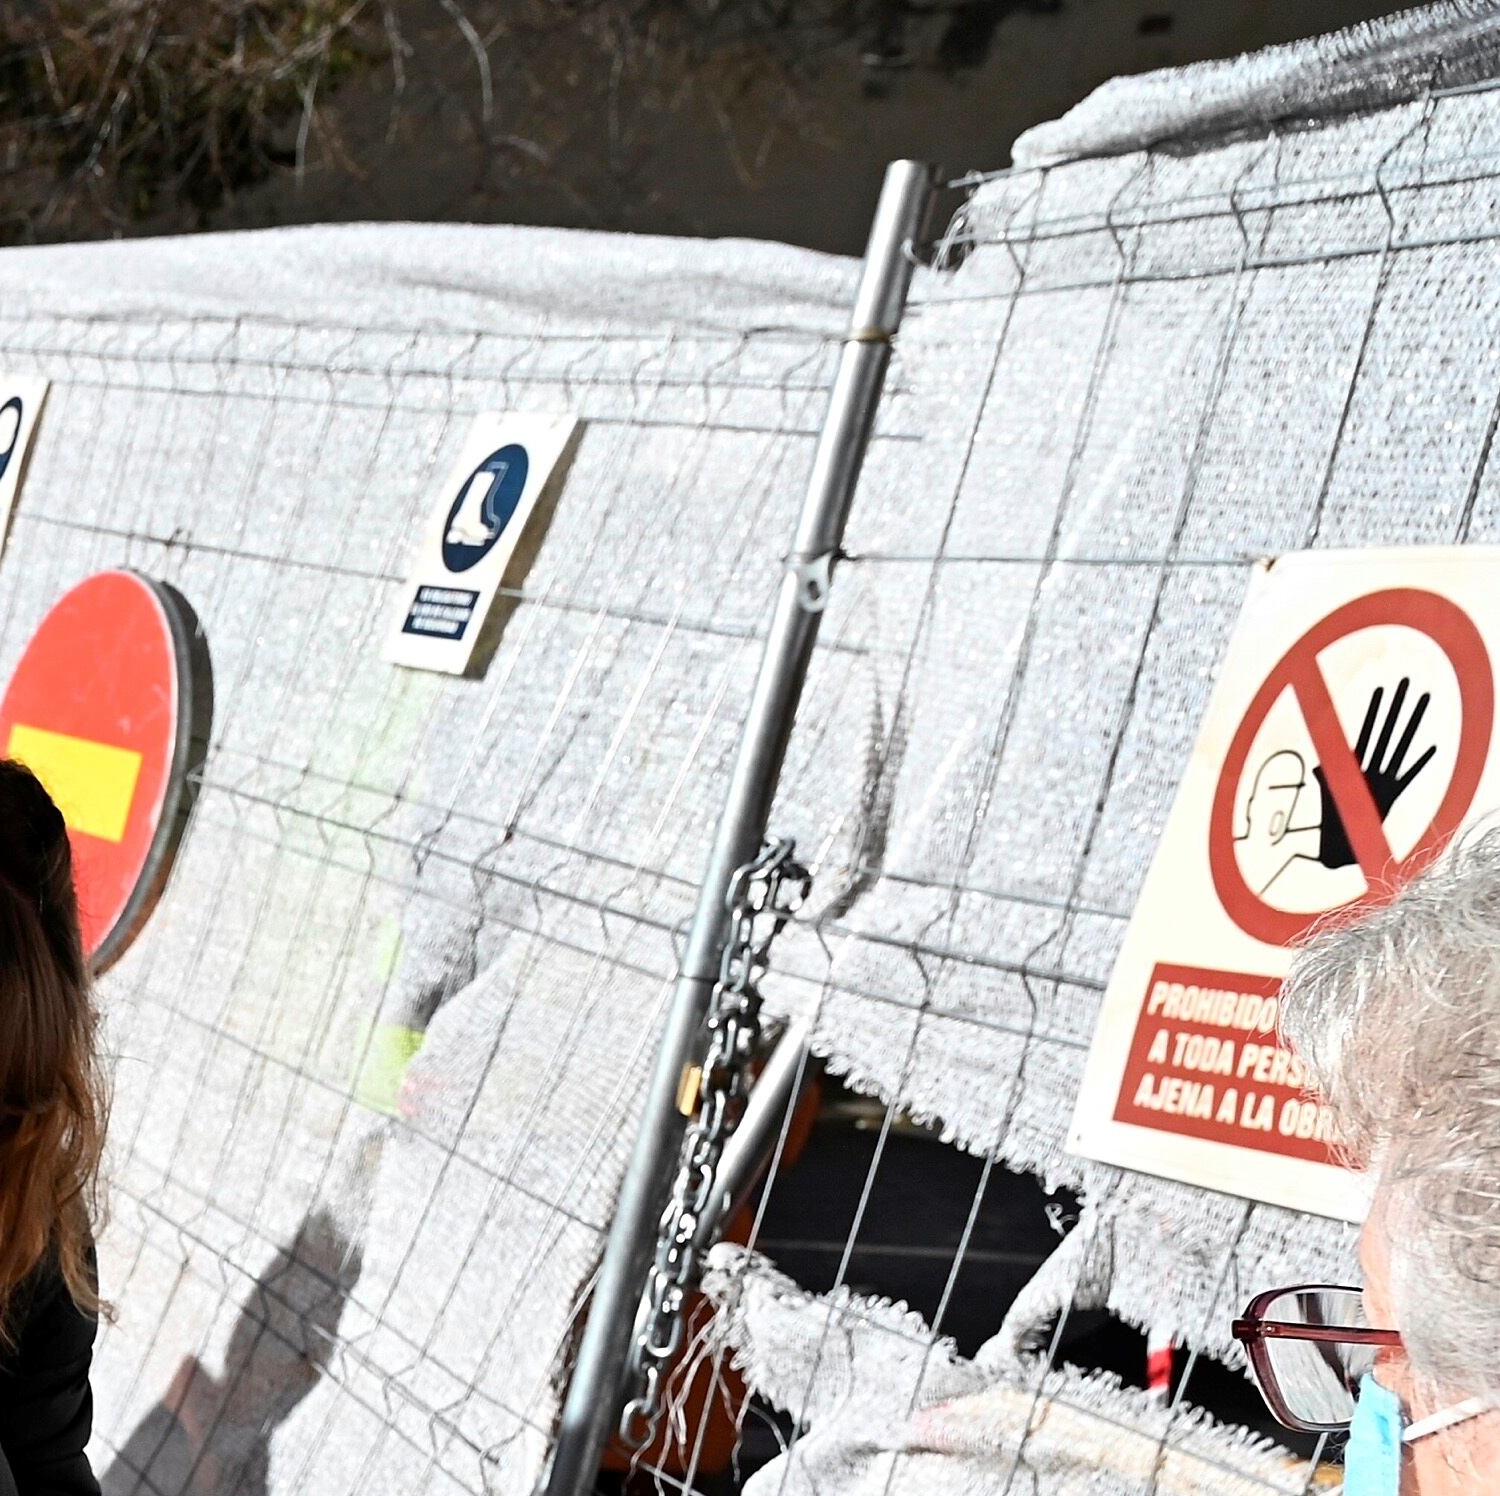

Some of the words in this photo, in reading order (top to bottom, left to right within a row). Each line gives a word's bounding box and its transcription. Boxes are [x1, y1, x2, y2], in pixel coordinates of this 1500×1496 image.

[1147, 981, 1277, 1033] PROHIBIDO
[1147, 1029, 1170, 1064] A
[1172, 1032, 1236, 1076] TODA
[1133, 1073, 1215, 1120] AJENA
[1215, 1088, 1239, 1125] A
[1239, 1091, 1275, 1132] LA
